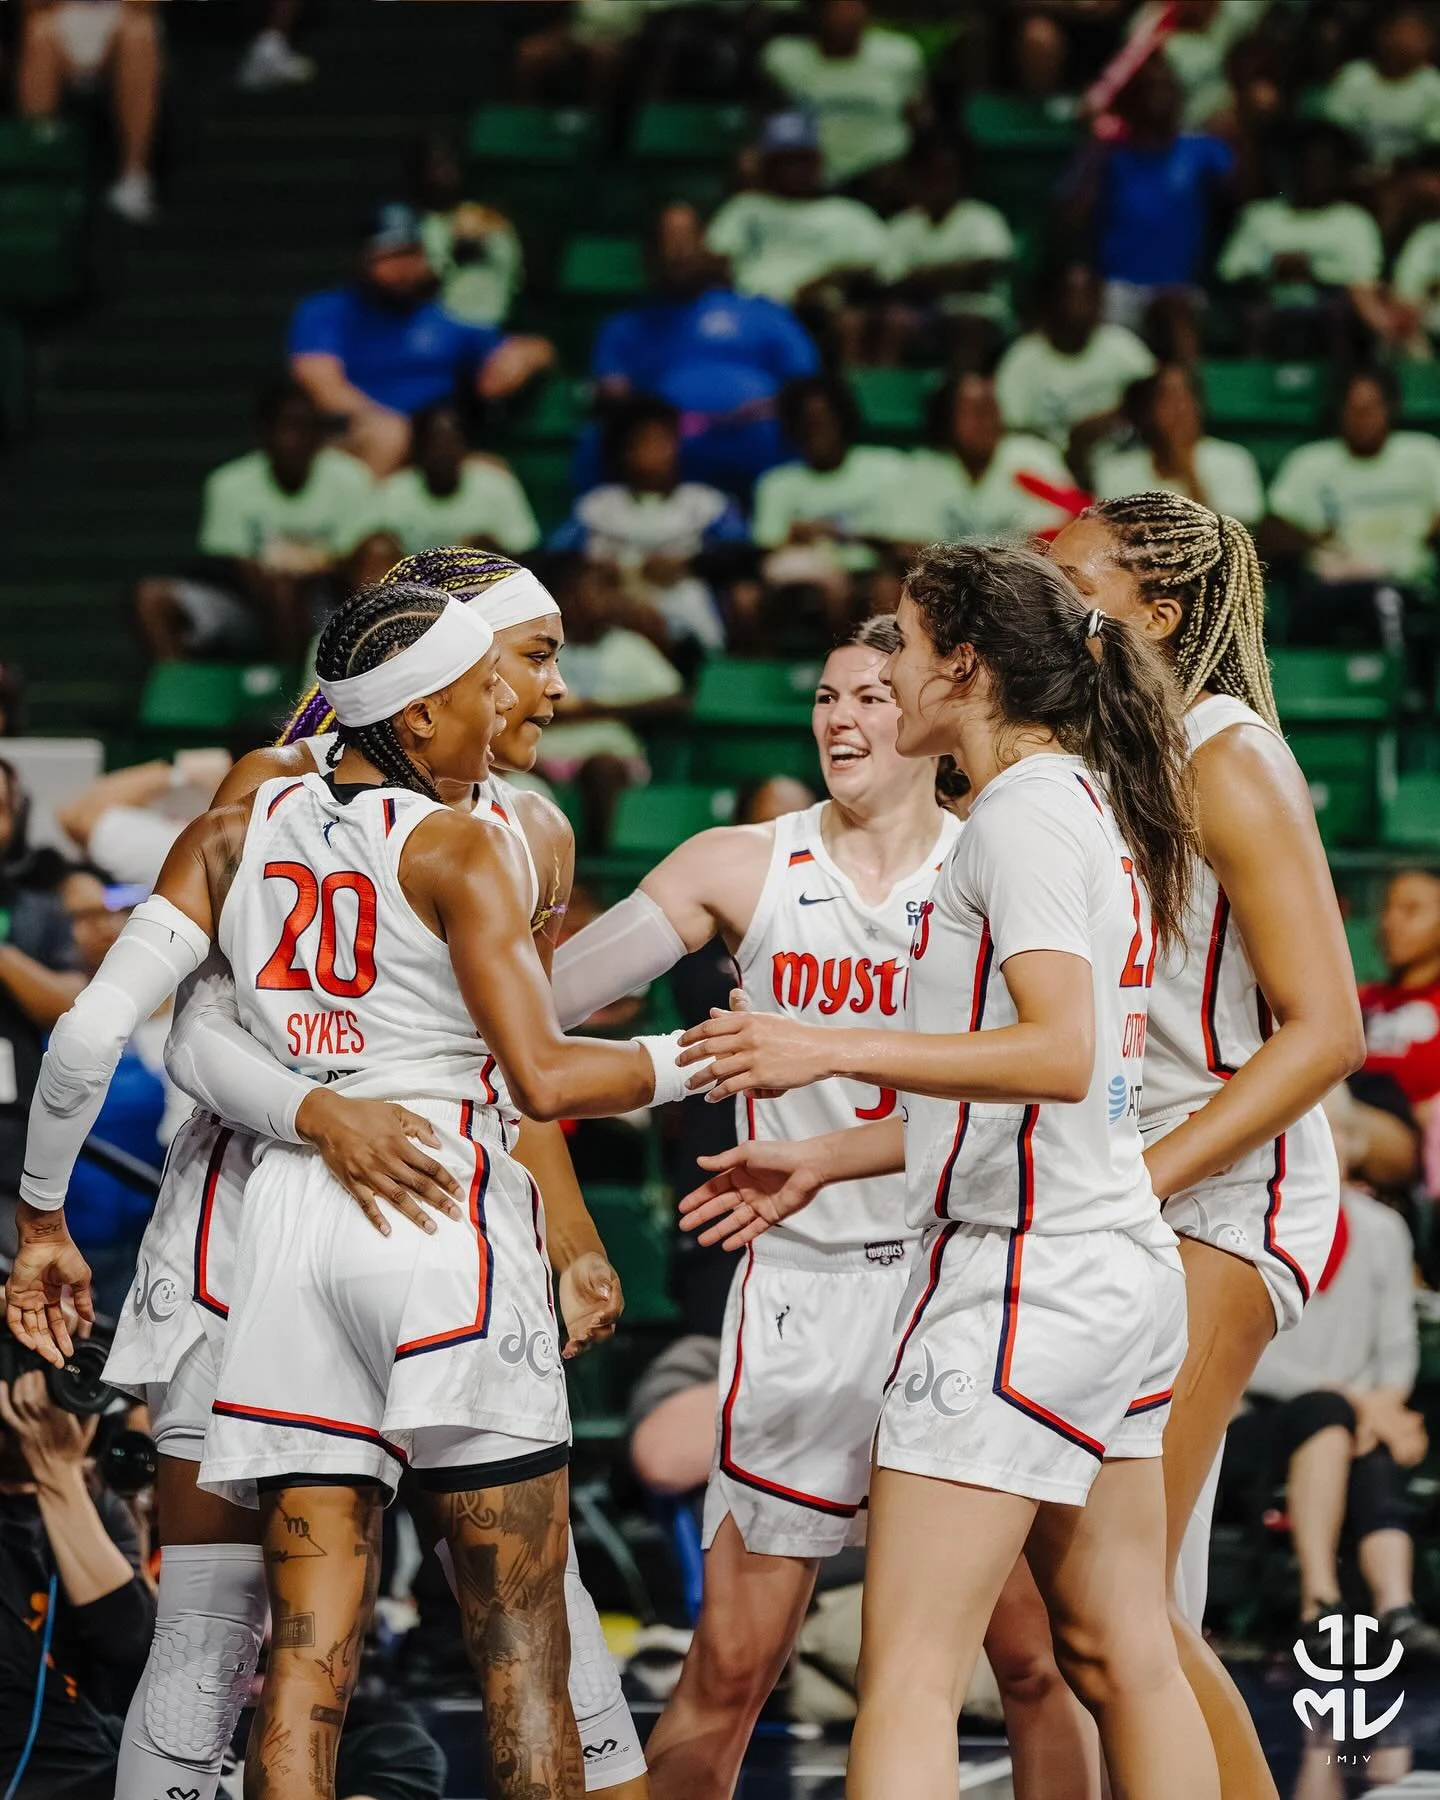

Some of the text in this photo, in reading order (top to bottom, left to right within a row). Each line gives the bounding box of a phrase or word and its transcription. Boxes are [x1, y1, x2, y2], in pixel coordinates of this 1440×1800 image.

[255, 861, 378, 998] 20
[772, 951, 909, 1016] myst
[286, 1010, 365, 1056] SYKES
[1122, 1013, 1147, 1058] CITR
